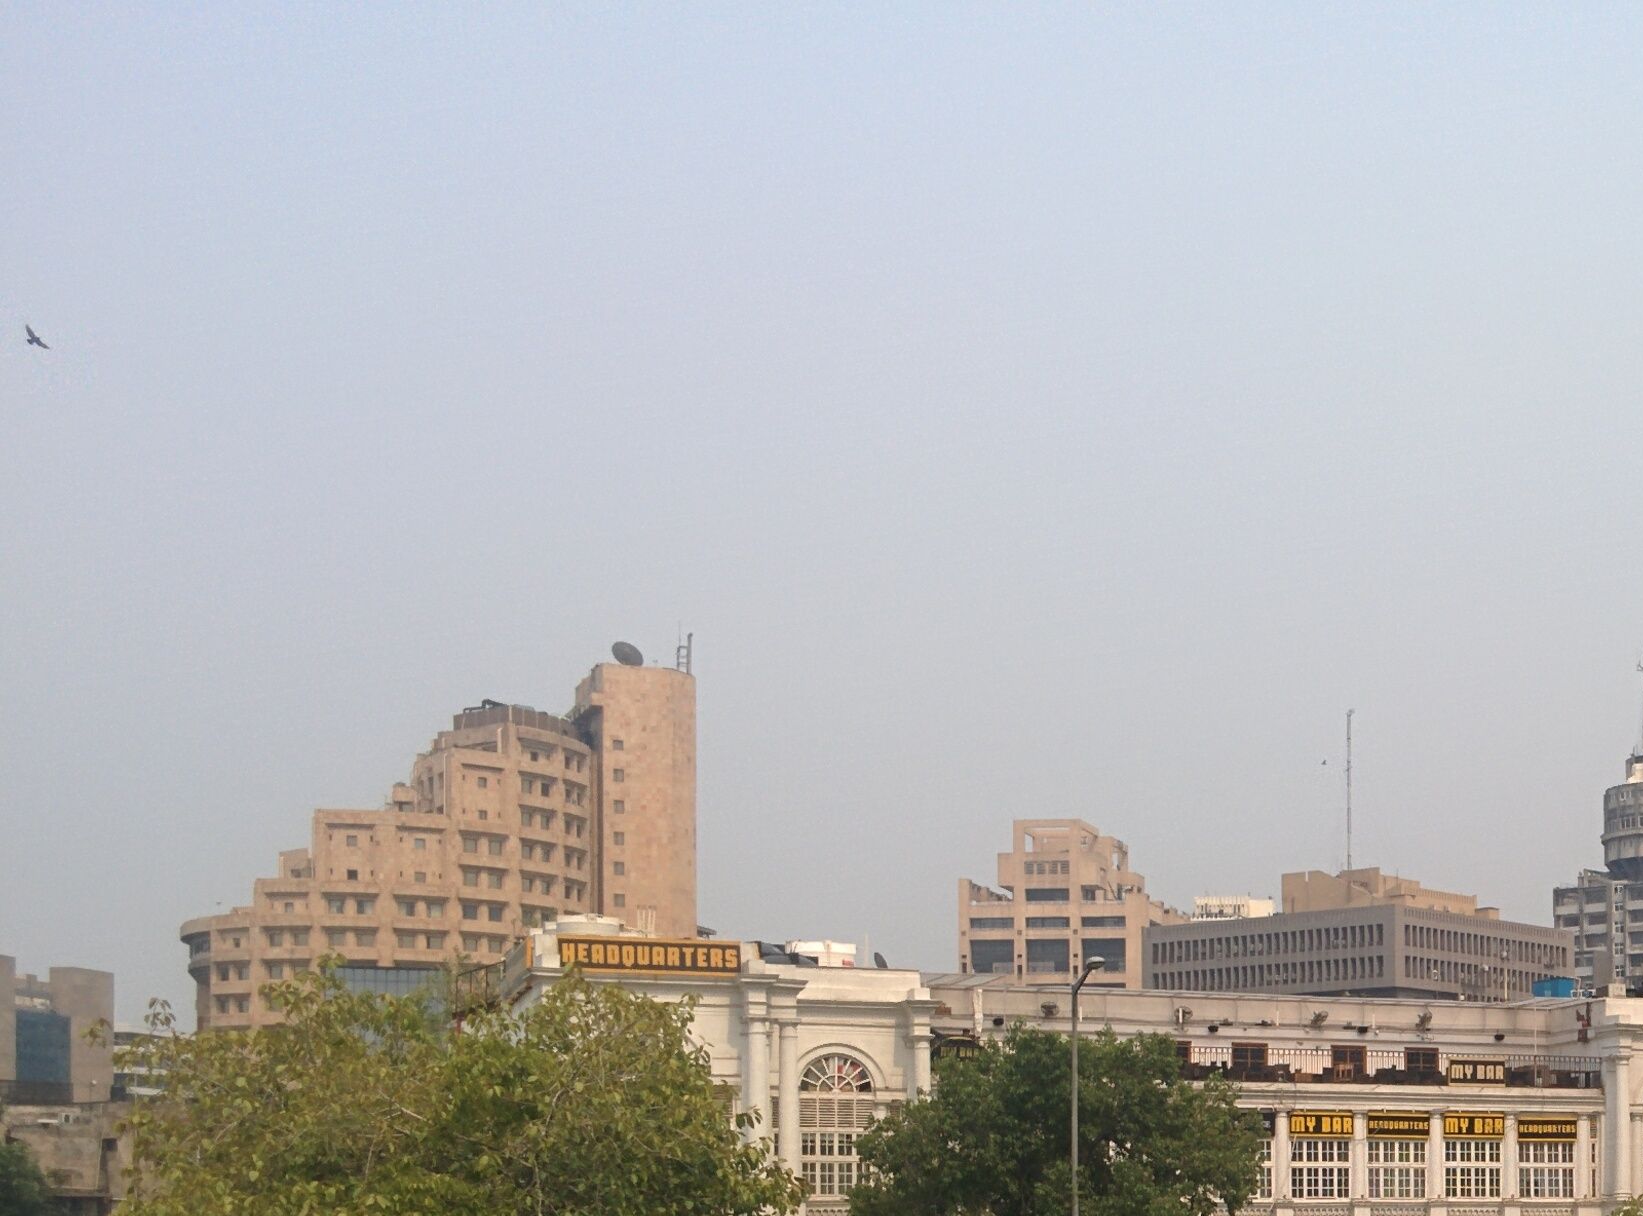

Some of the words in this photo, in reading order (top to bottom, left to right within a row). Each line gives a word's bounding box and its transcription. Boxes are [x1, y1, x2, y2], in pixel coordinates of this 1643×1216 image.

[562, 943, 738, 968] HEADQUARTERS
[1451, 1064, 1473, 1079] MY
[1476, 1065, 1504, 1080] BAR
[1290, 1116, 1315, 1132] MY
[1321, 1117, 1353, 1133] BAR
[1368, 1120, 1429, 1130] HEADQUARTERS
[1445, 1117, 1469, 1133] MY
[1473, 1117, 1504, 1134] BAR
[1519, 1124, 1576, 1134] HEADQUARTERS
